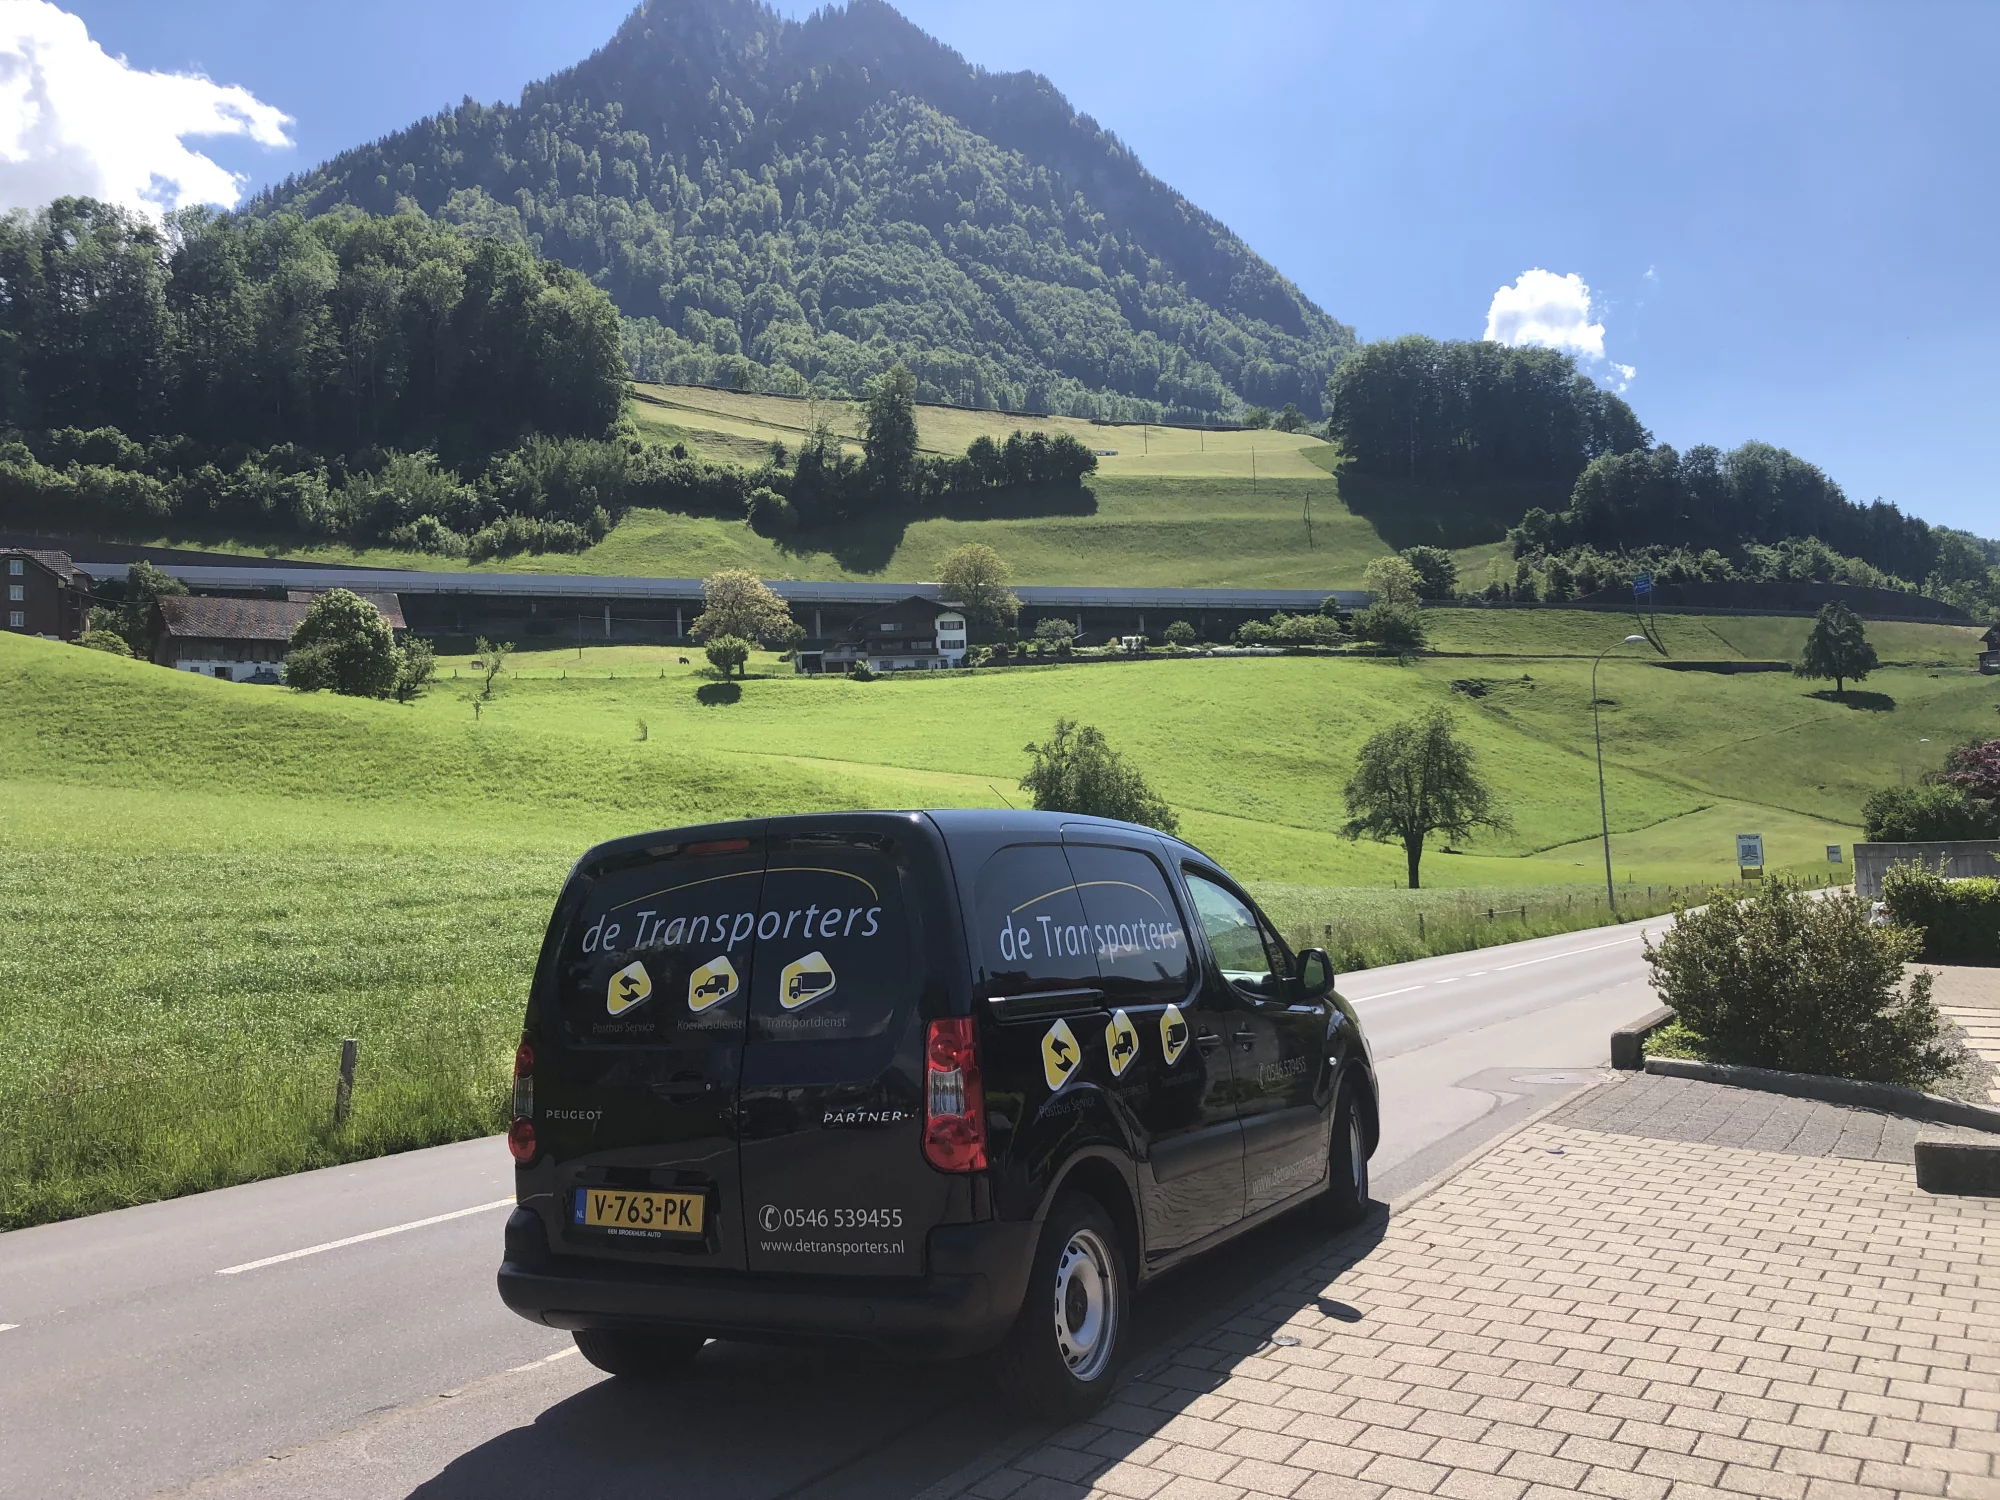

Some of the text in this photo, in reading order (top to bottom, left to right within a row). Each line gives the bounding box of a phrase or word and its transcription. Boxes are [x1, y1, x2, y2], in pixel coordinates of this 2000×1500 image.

[582, 903, 882, 953] de Transporters
[999, 914, 1177, 963] de Transporters
[592, 1021, 655, 1034] Postbus Service
[767, 1016, 847, 1031] Transportdienst
[545, 1109, 603, 1120] PEUGEOT
[1038, 1095, 1096, 1119] Postbus Service
[823, 1111, 902, 1123] PARTNER
[576, 1209, 584, 1219] NL
[594, 1194, 692, 1227] V-763-PK
[783, 1208, 903, 1228] 0546 539455
[760, 1238, 905, 1256] www.detransporters.nl
